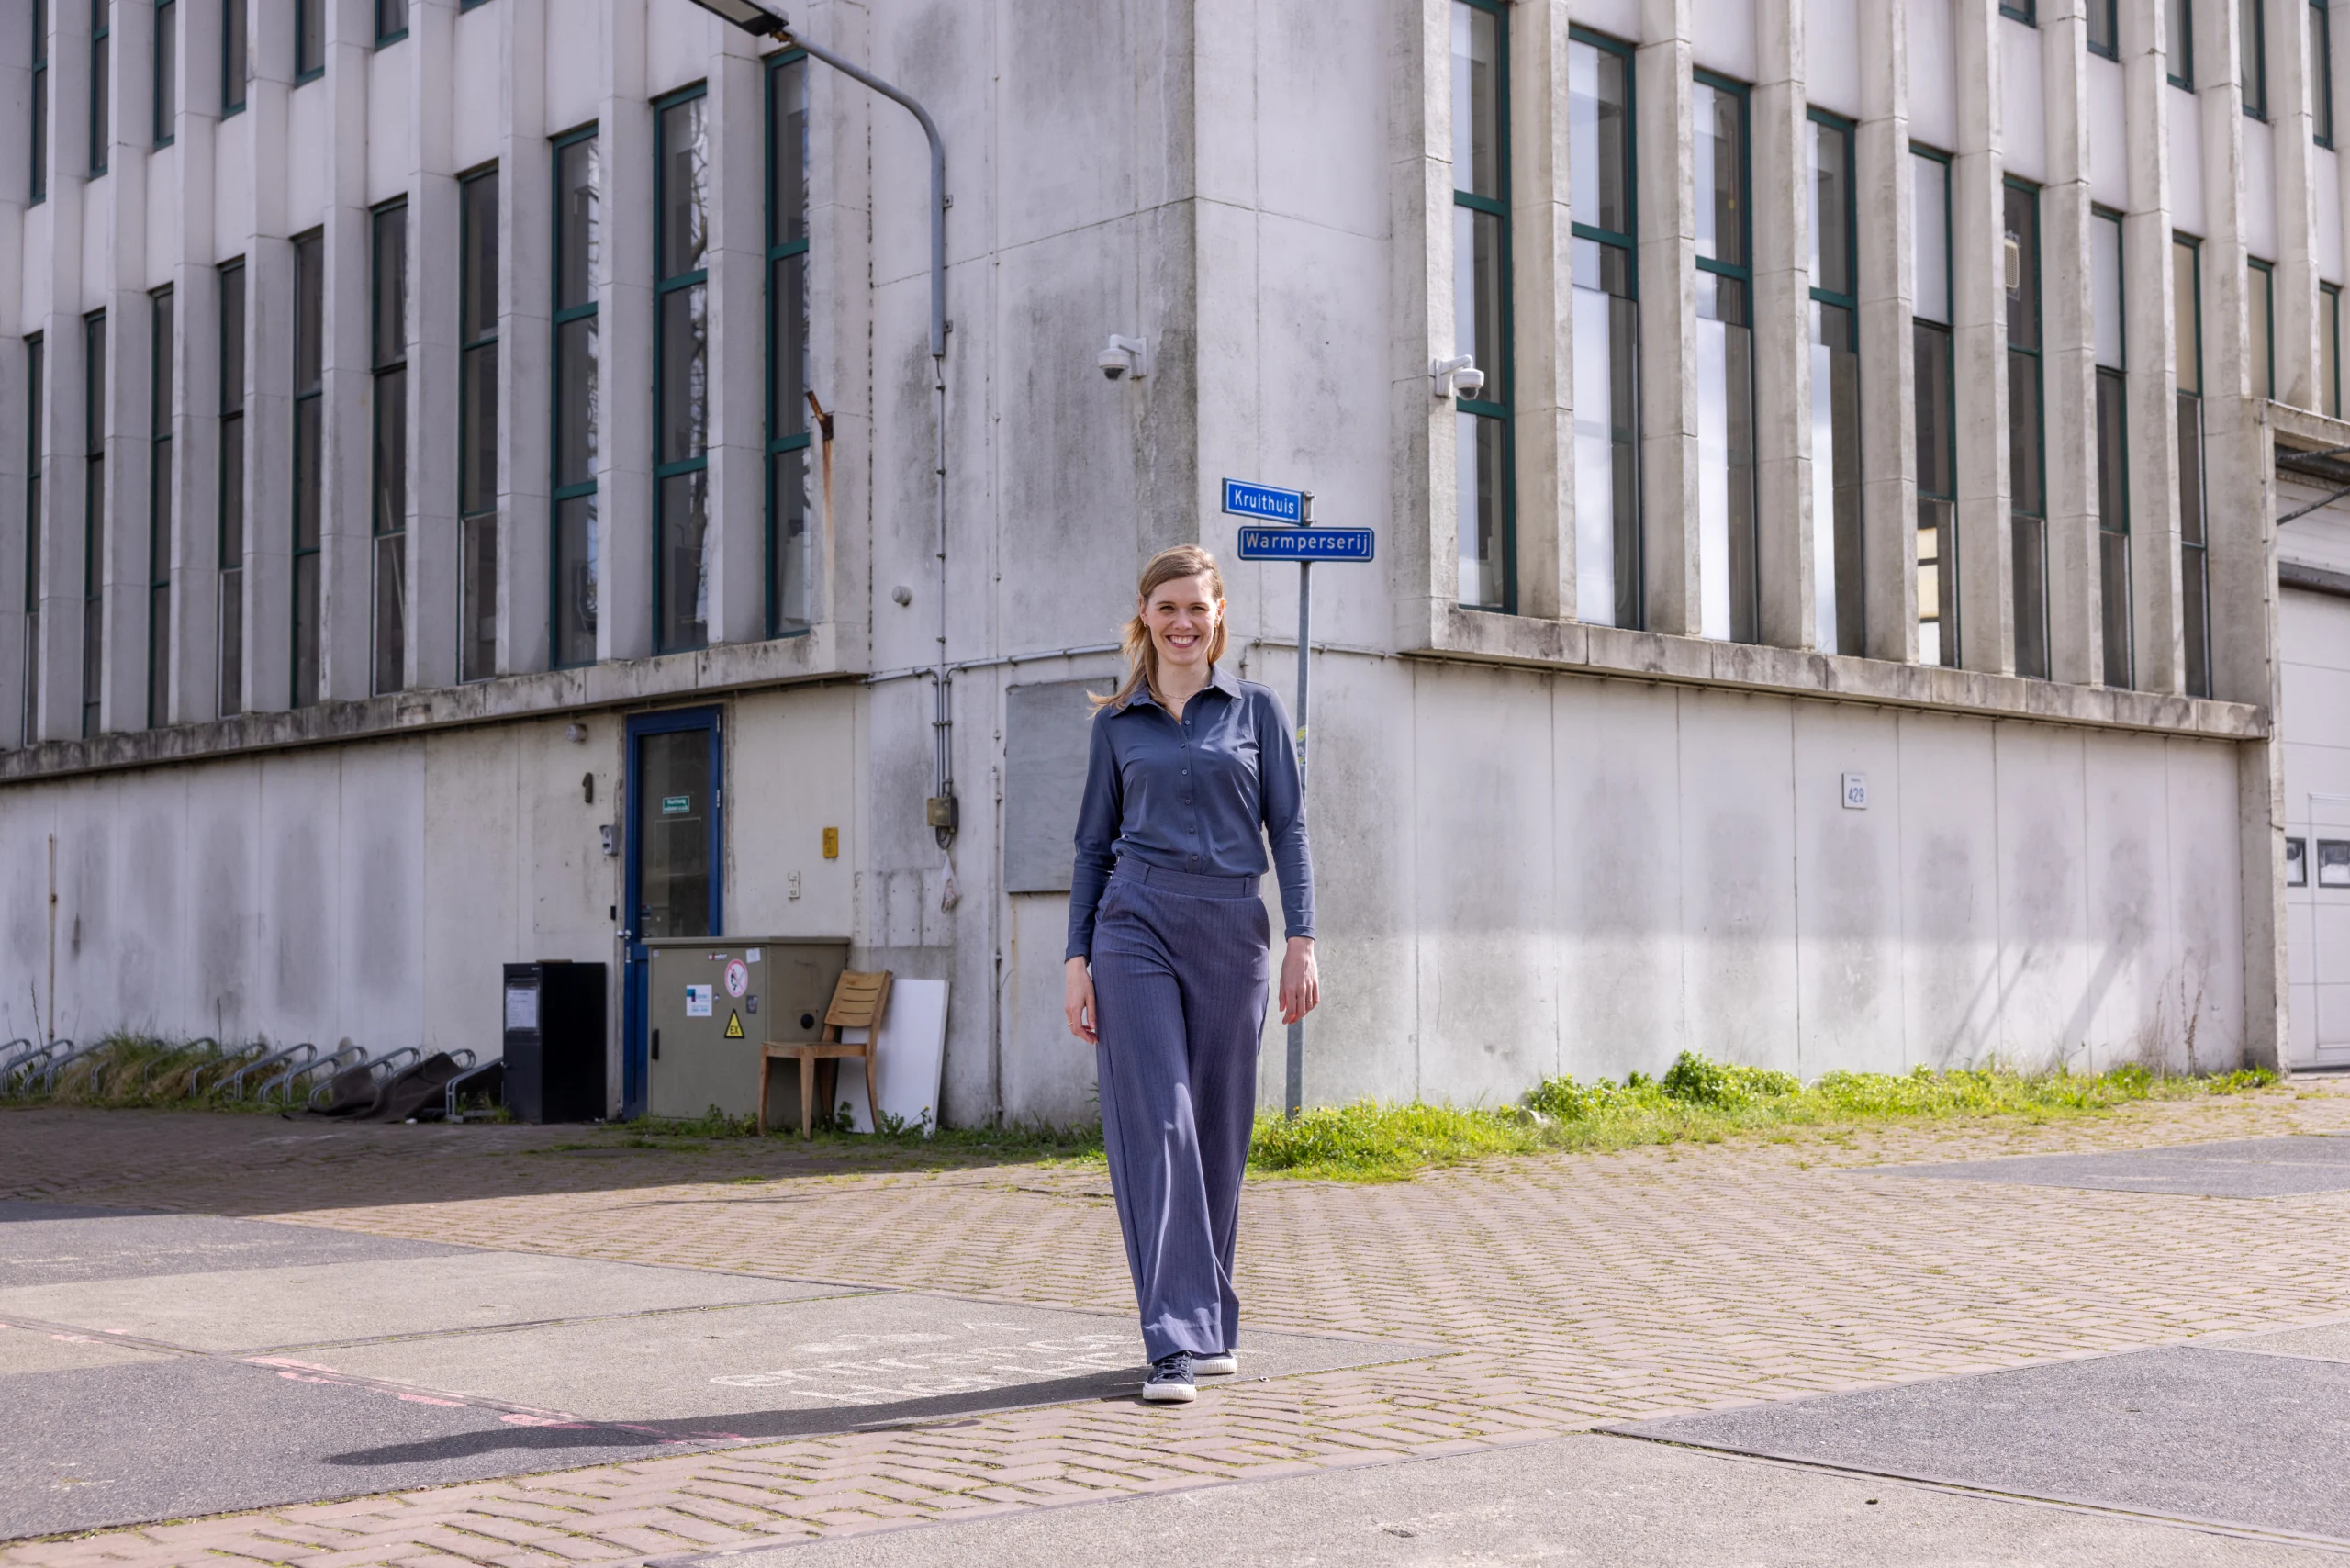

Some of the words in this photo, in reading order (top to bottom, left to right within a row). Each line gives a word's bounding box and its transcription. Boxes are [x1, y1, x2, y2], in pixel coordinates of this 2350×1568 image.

[1235, 489, 1294, 515] Kruithuis
[1245, 532, 1368, 554] Warmperserij
[582, 772, 593, 803] 1
[1848, 787, 1864, 803] 429
[730, 1025, 740, 1035] EX
